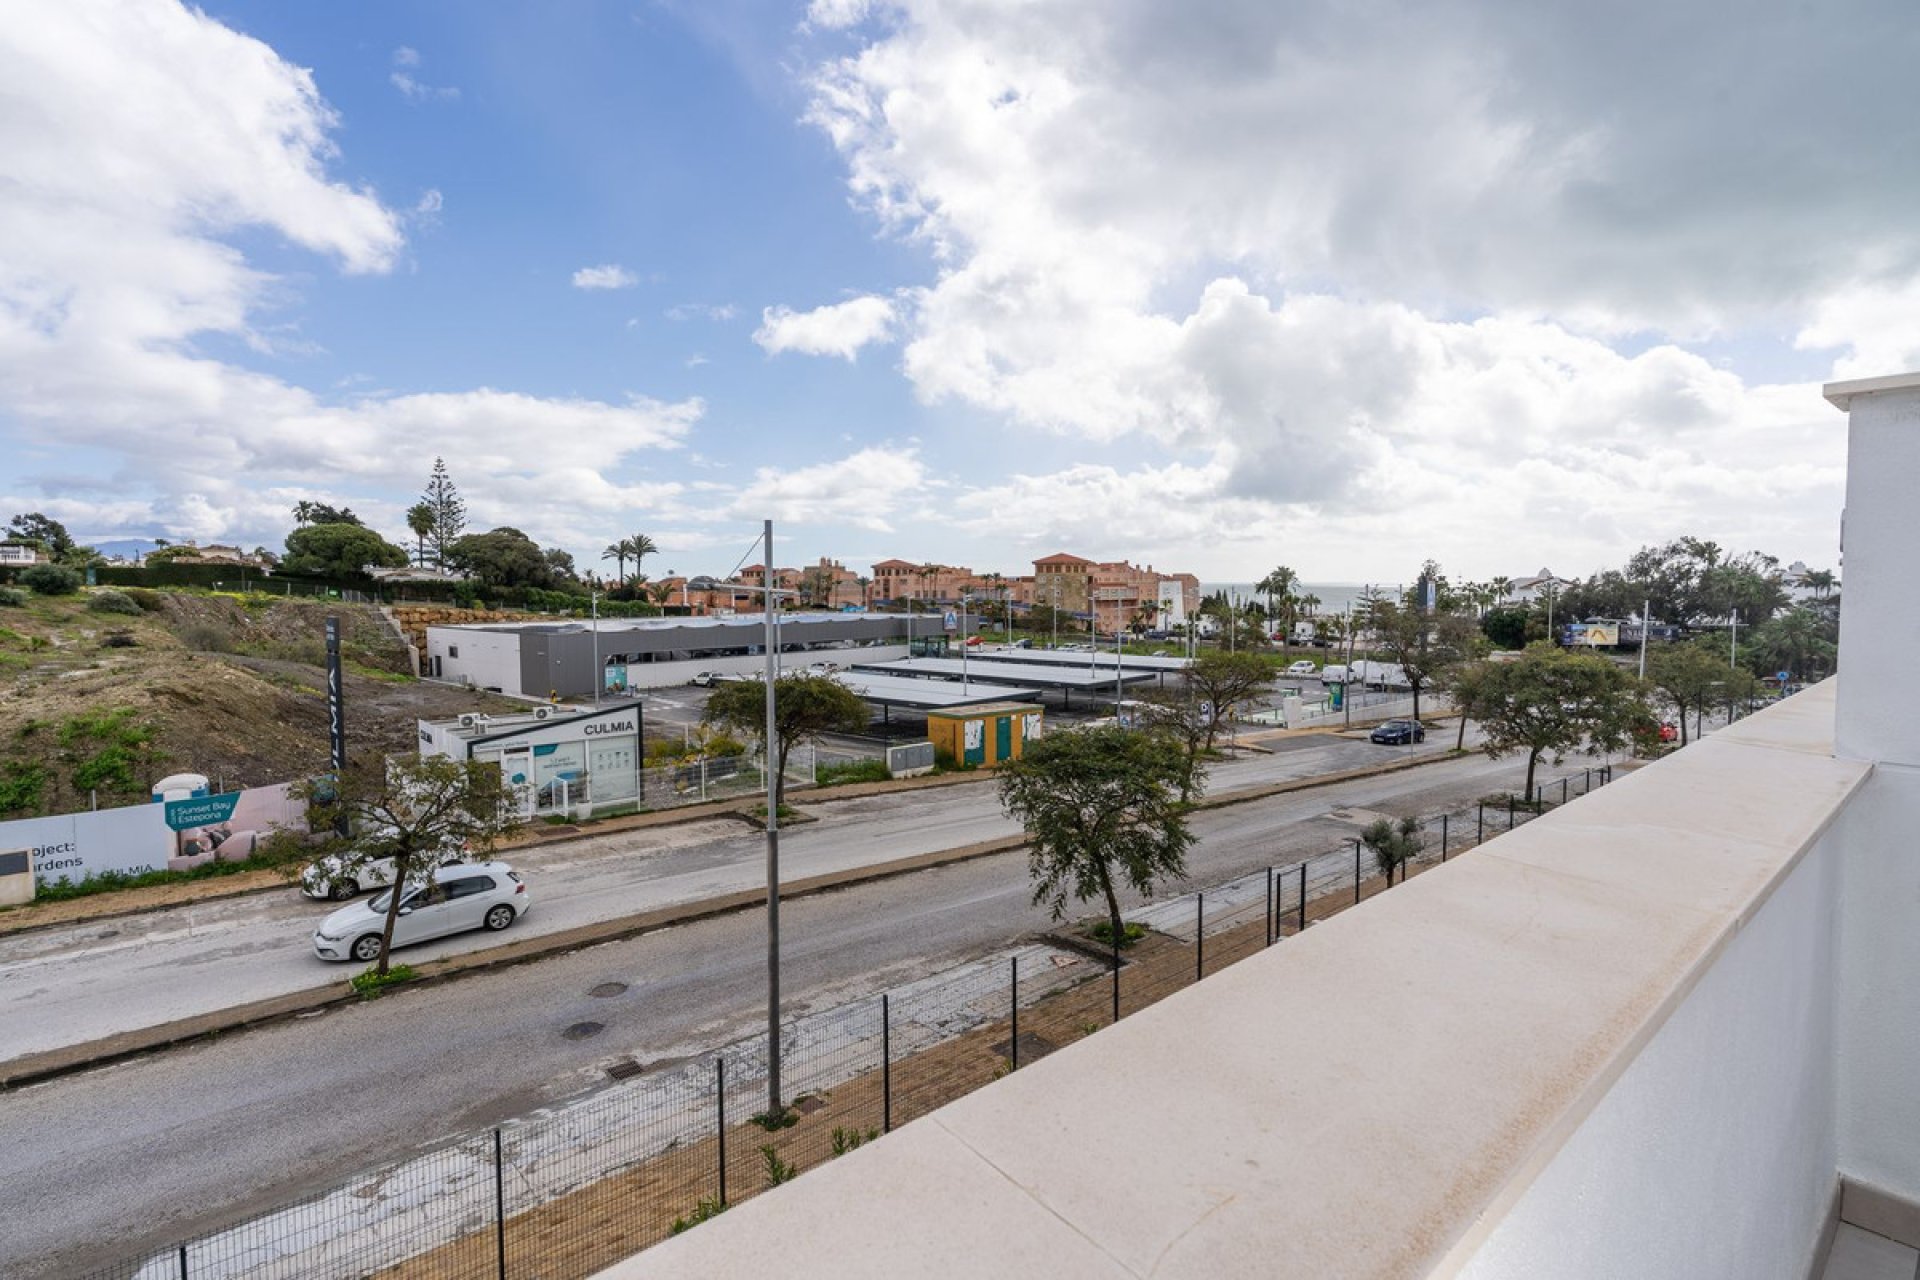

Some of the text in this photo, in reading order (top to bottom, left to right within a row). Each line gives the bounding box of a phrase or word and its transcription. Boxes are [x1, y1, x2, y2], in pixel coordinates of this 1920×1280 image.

[584, 720, 634, 735] CULMIA
[177, 802, 231, 814] Sunset Bay
[178, 811, 222, 824] Estepona
[32, 842, 75, 858] oject:
[33, 857, 83, 872] rdens
